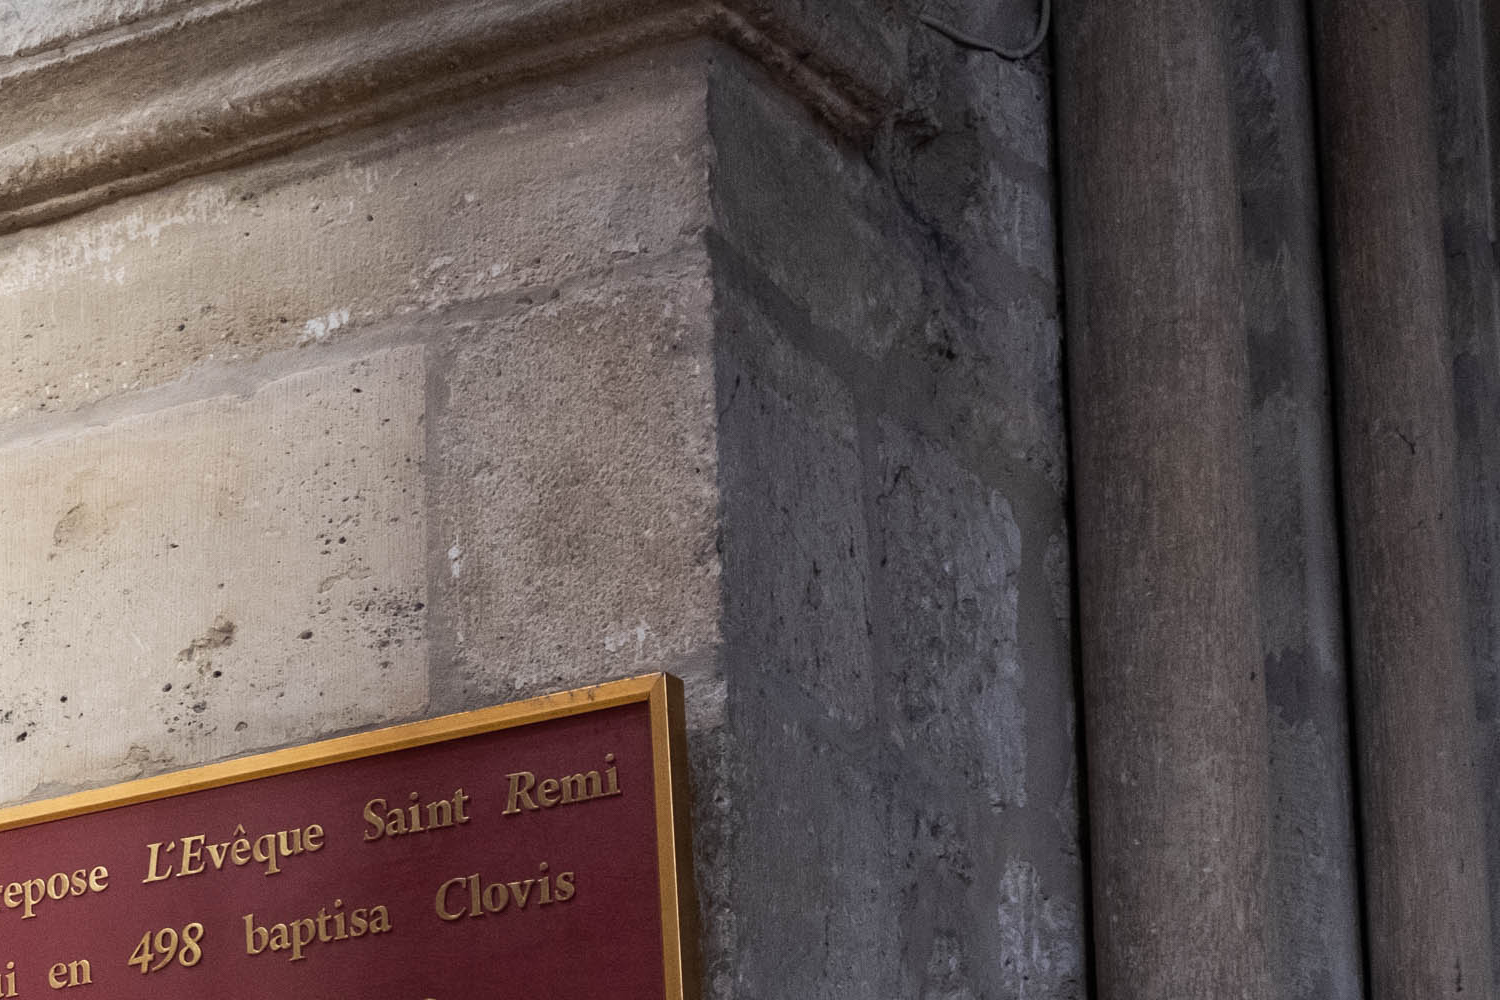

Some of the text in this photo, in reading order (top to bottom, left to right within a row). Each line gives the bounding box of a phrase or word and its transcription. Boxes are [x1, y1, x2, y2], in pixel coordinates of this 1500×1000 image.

[363, 787, 470, 842] Saint
[501, 753, 621, 816] Remi
[48, 958, 93, 991] en
[127, 922, 205, 975] 498
[242, 898, 393, 962] baptisa
[435, 862, 576, 922] Clovis
